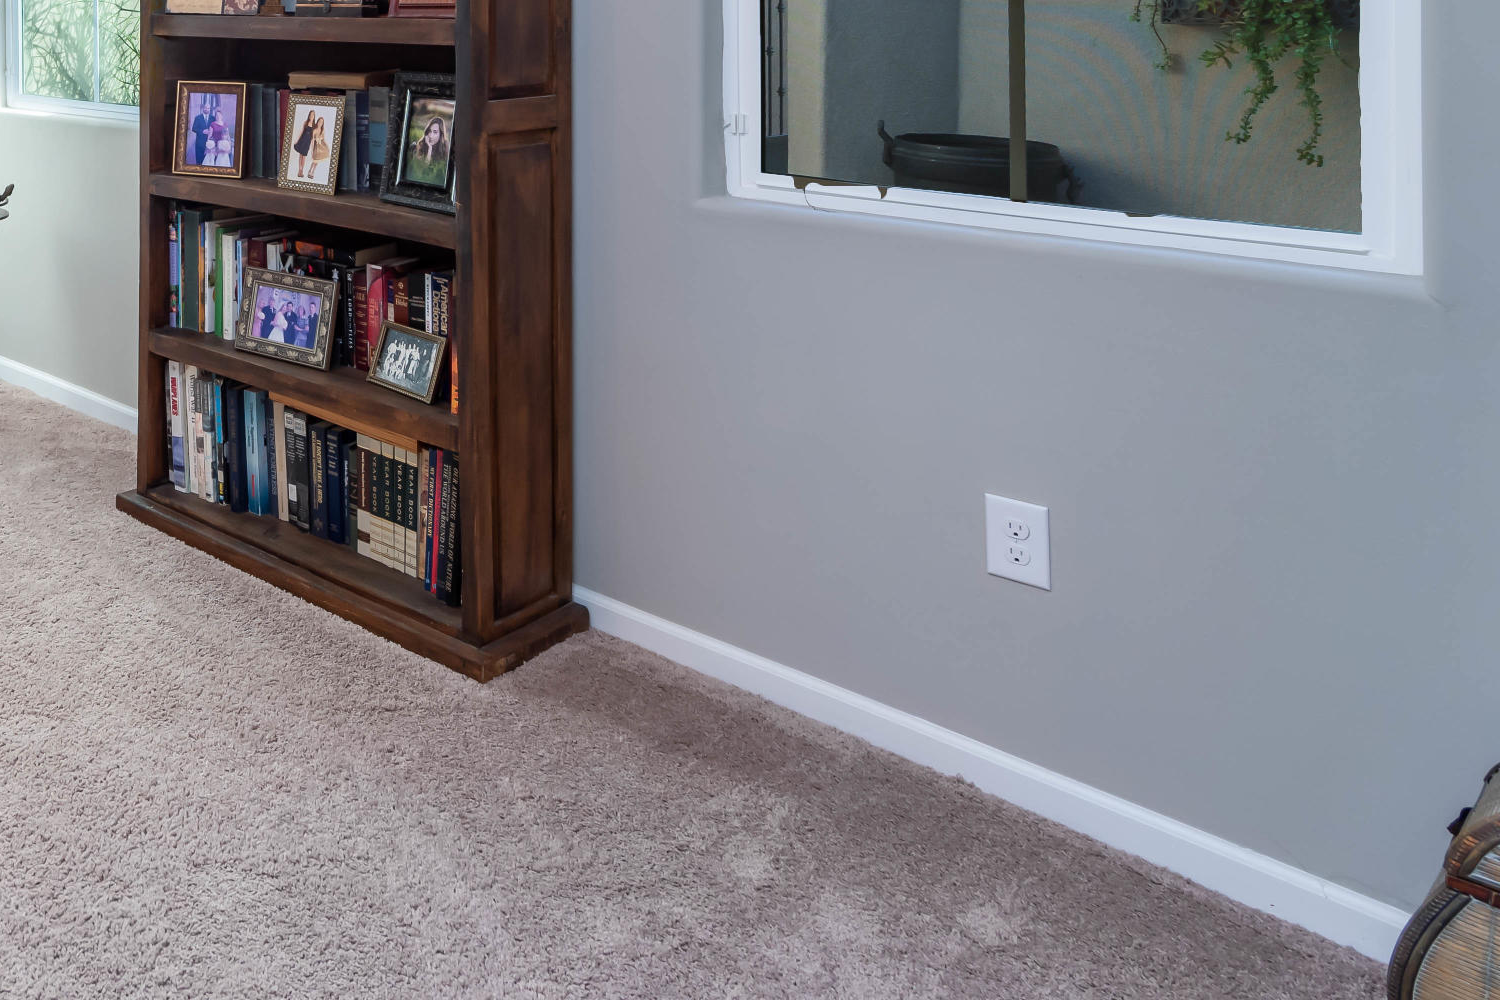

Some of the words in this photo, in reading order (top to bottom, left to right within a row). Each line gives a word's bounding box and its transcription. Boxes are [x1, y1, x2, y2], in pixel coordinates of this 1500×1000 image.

[432, 290, 442, 336] Dictiona
[439, 284, 449, 335] American
[170, 376, 180, 416] WARPLANES
[430, 466, 435, 477] MY
[450, 485, 458, 519] AMAZING
[439, 544, 445, 555] US
[448, 521, 456, 549] WORLD
[447, 549, 454, 560] OF
[445, 562, 453, 593] NATURE
